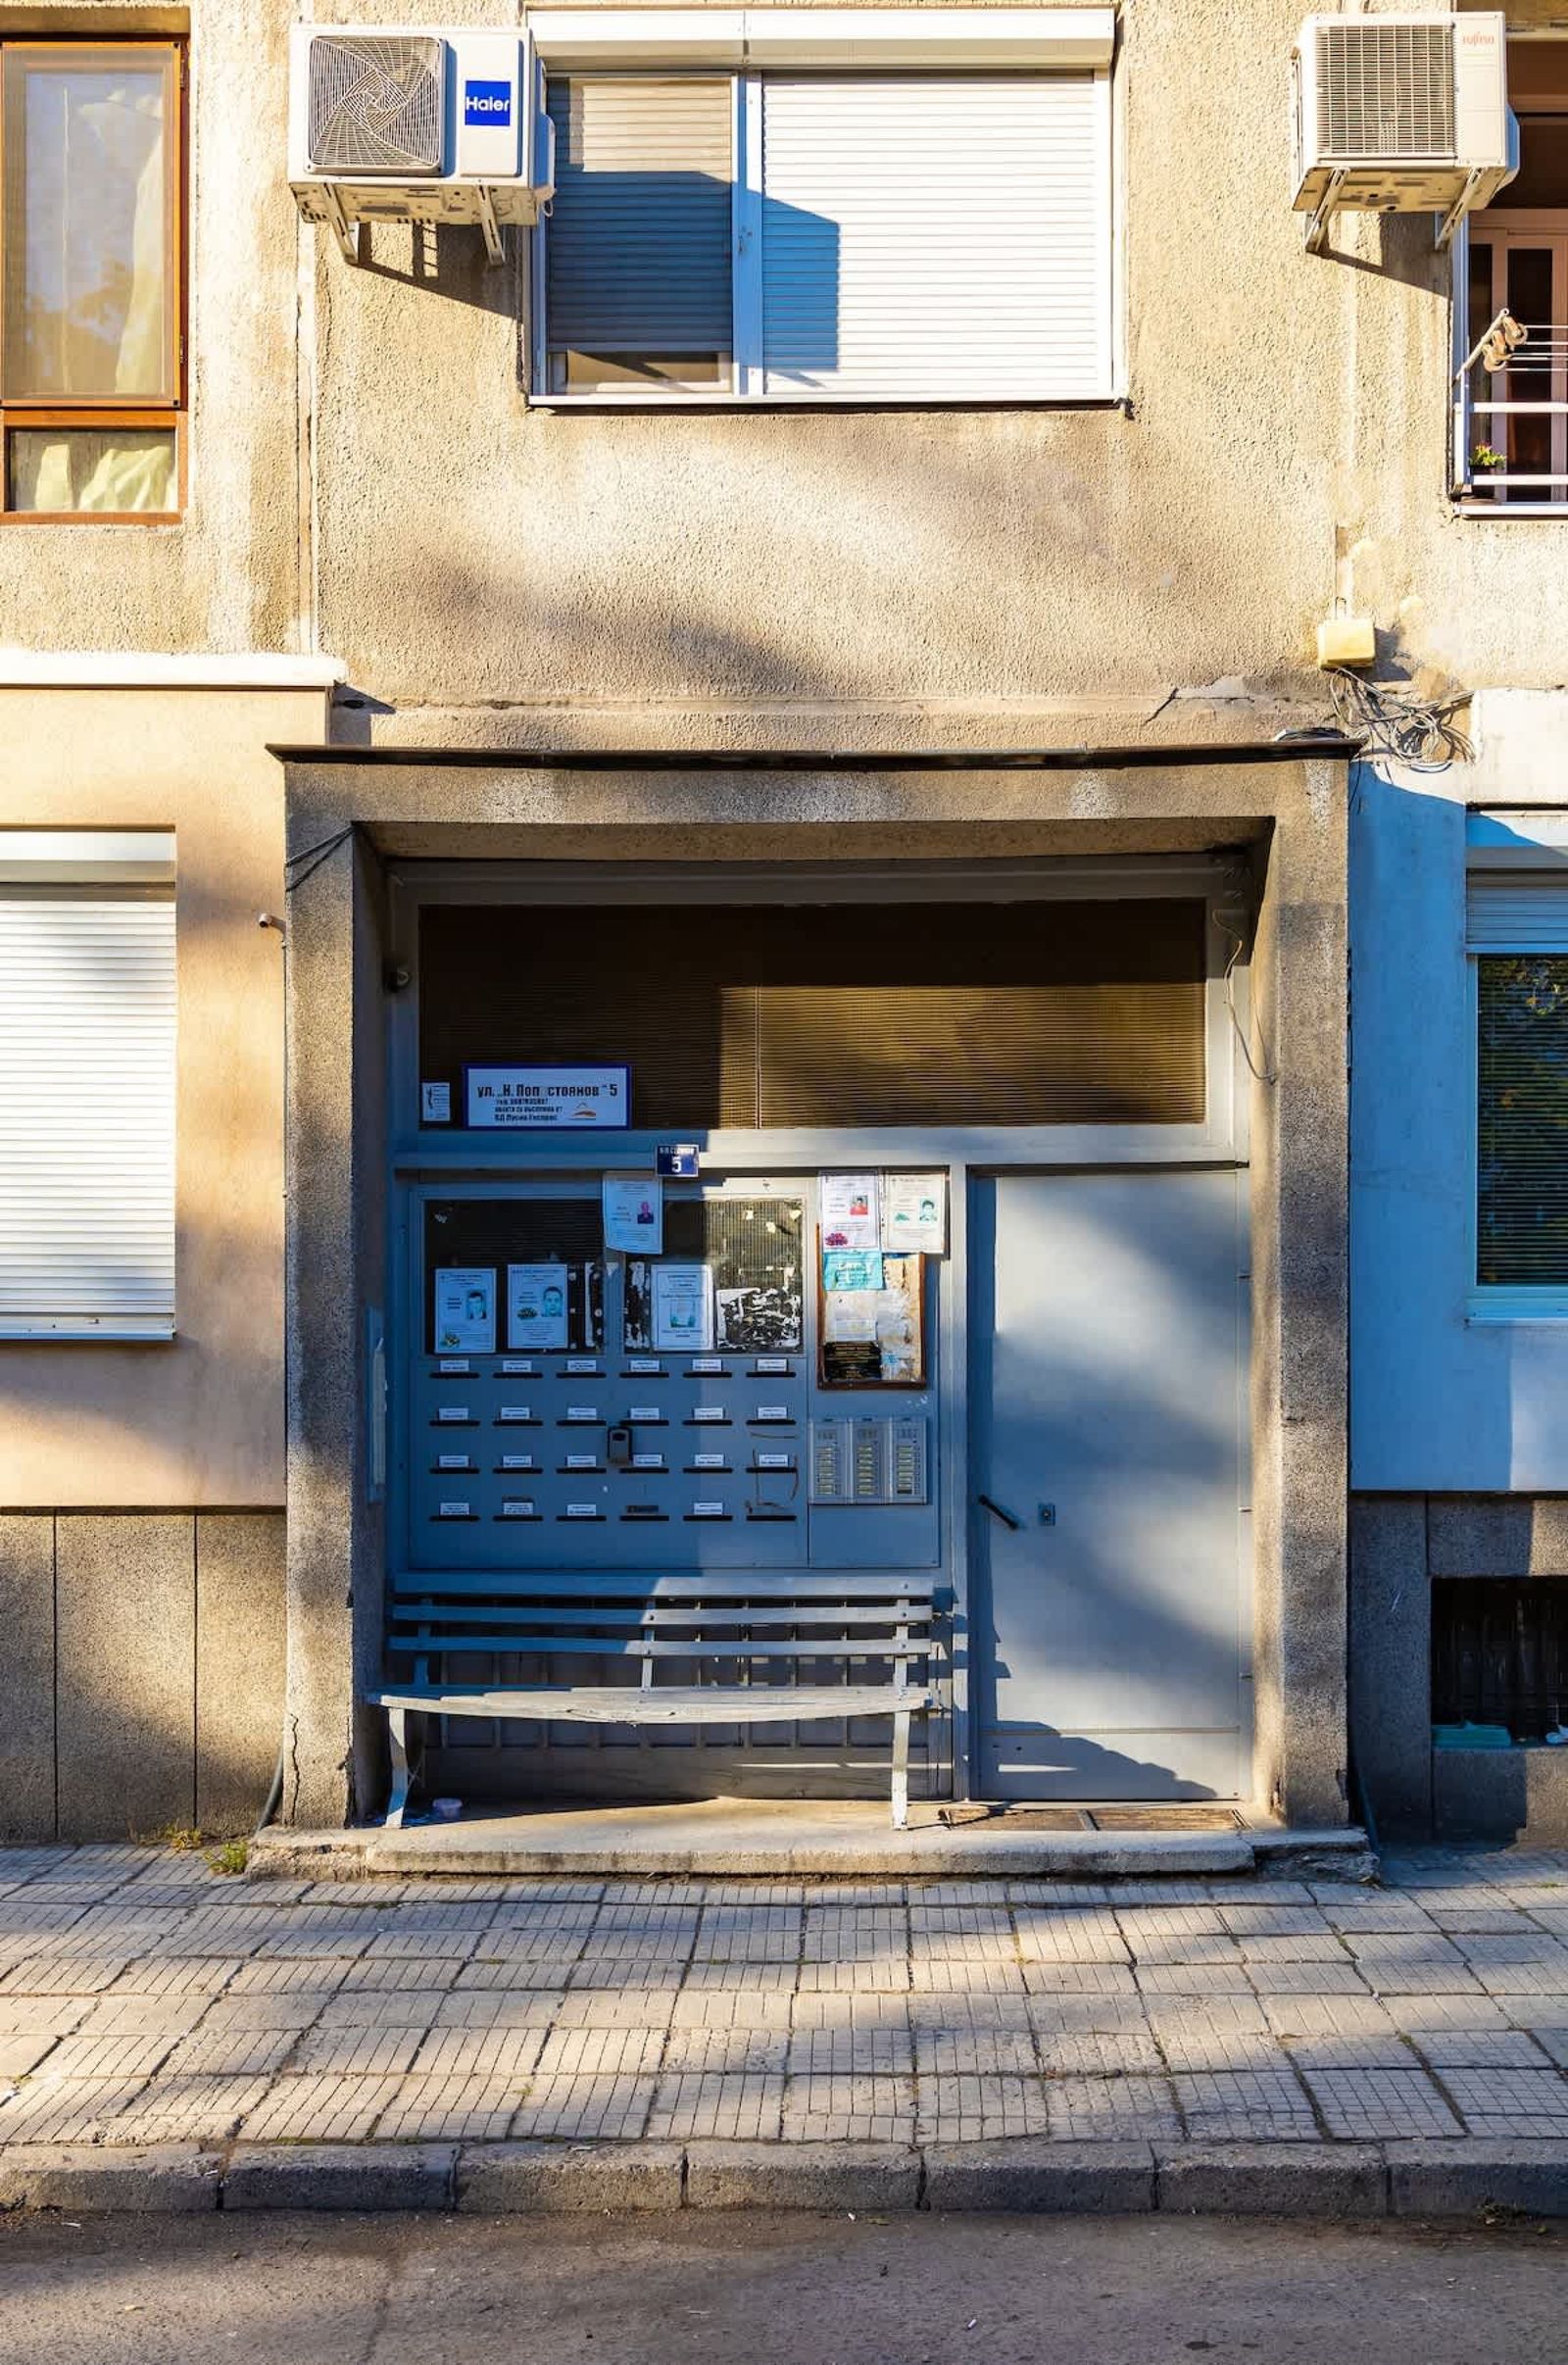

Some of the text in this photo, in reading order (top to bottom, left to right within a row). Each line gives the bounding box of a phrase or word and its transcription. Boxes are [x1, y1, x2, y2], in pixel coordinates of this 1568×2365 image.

[466, 96, 510, 112] Haier
[477, 1086, 495, 1098] ул.
[516, 1084, 540, 1097] Поп
[610, 1083, 617, 1097] 5
[671, 1157, 682, 1173] 5
